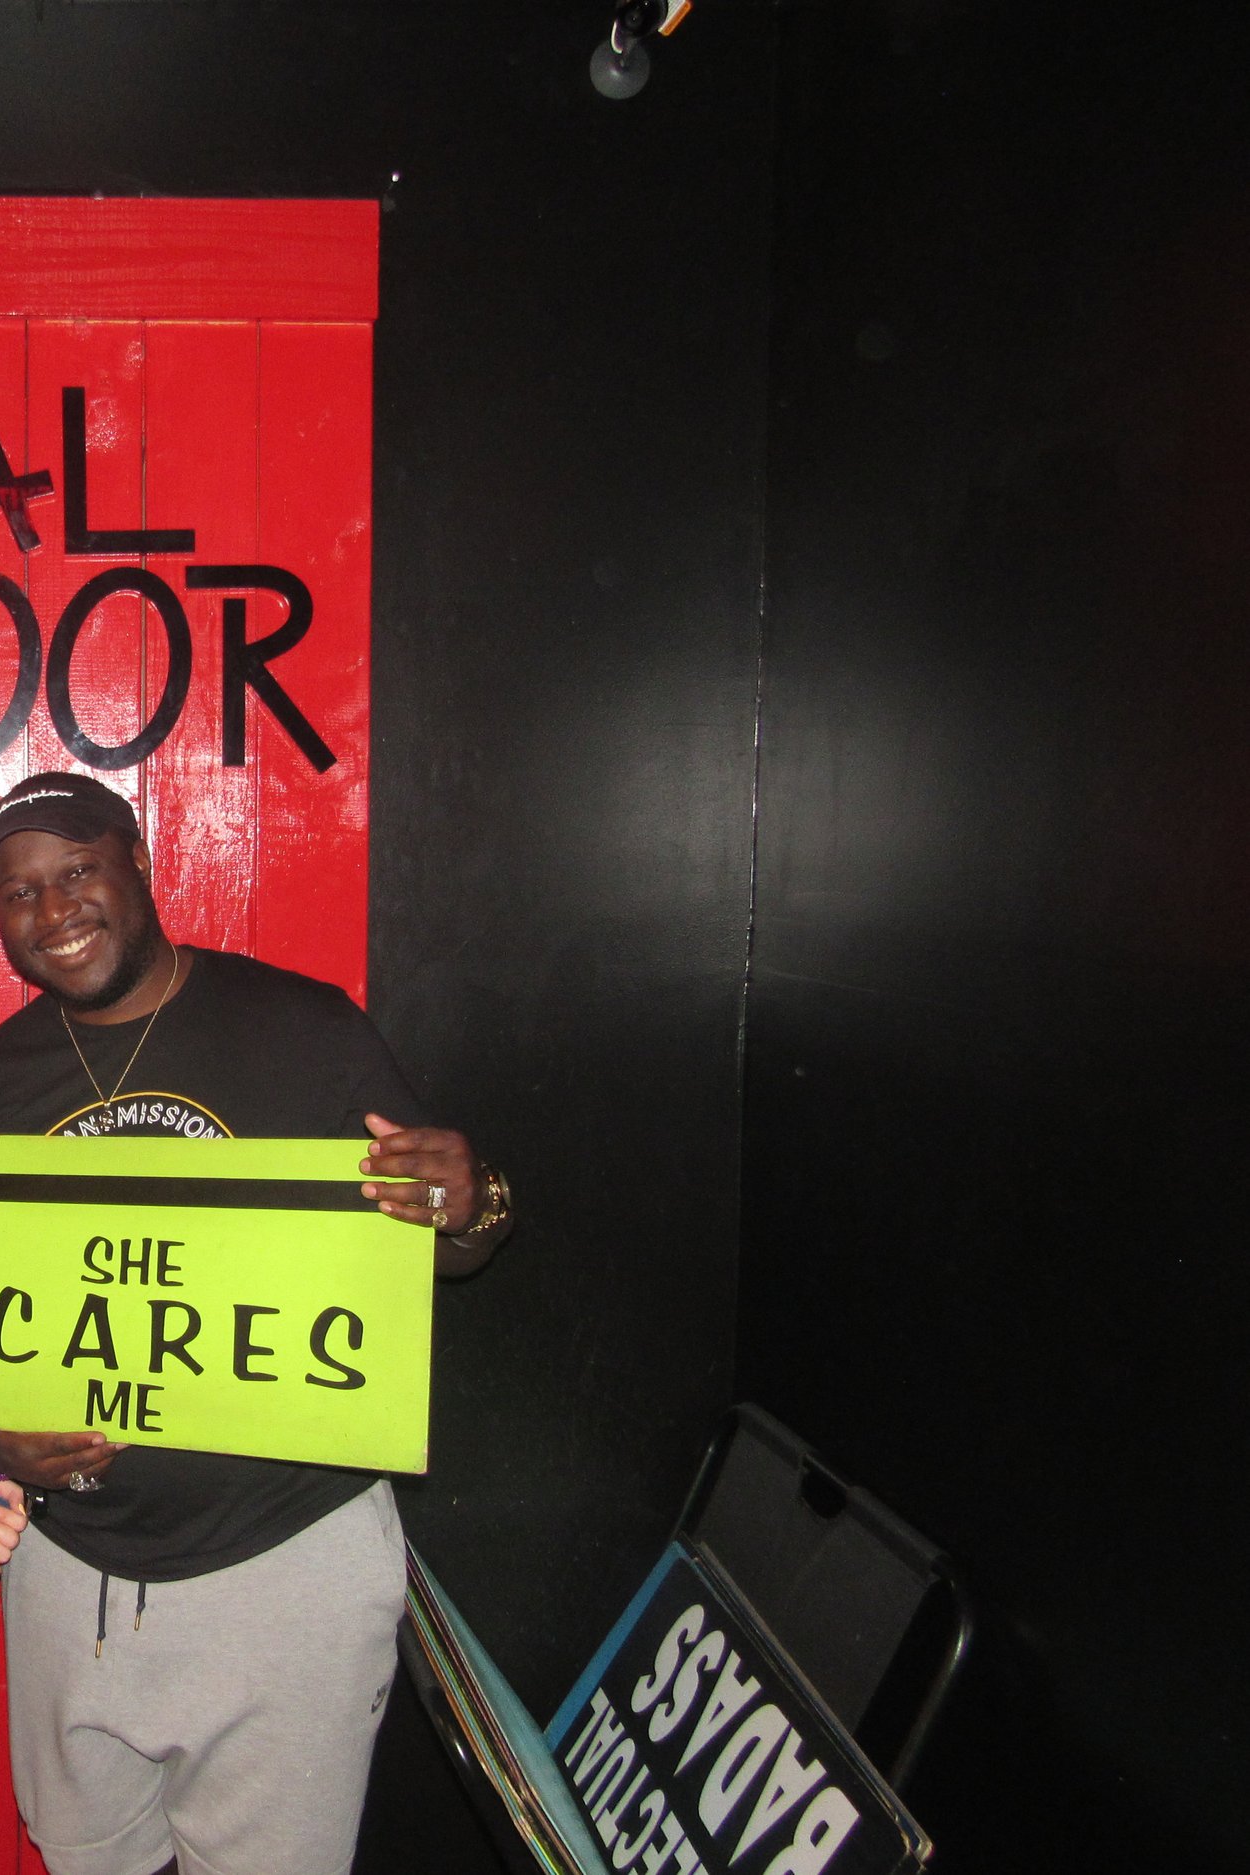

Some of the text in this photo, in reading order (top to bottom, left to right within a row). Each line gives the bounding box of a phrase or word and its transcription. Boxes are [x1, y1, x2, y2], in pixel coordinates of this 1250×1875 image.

[81, 1236, 185, 1287] SHE
[85, 1379, 165, 1432] ME
[631, 1603, 861, 1875] BADASS
